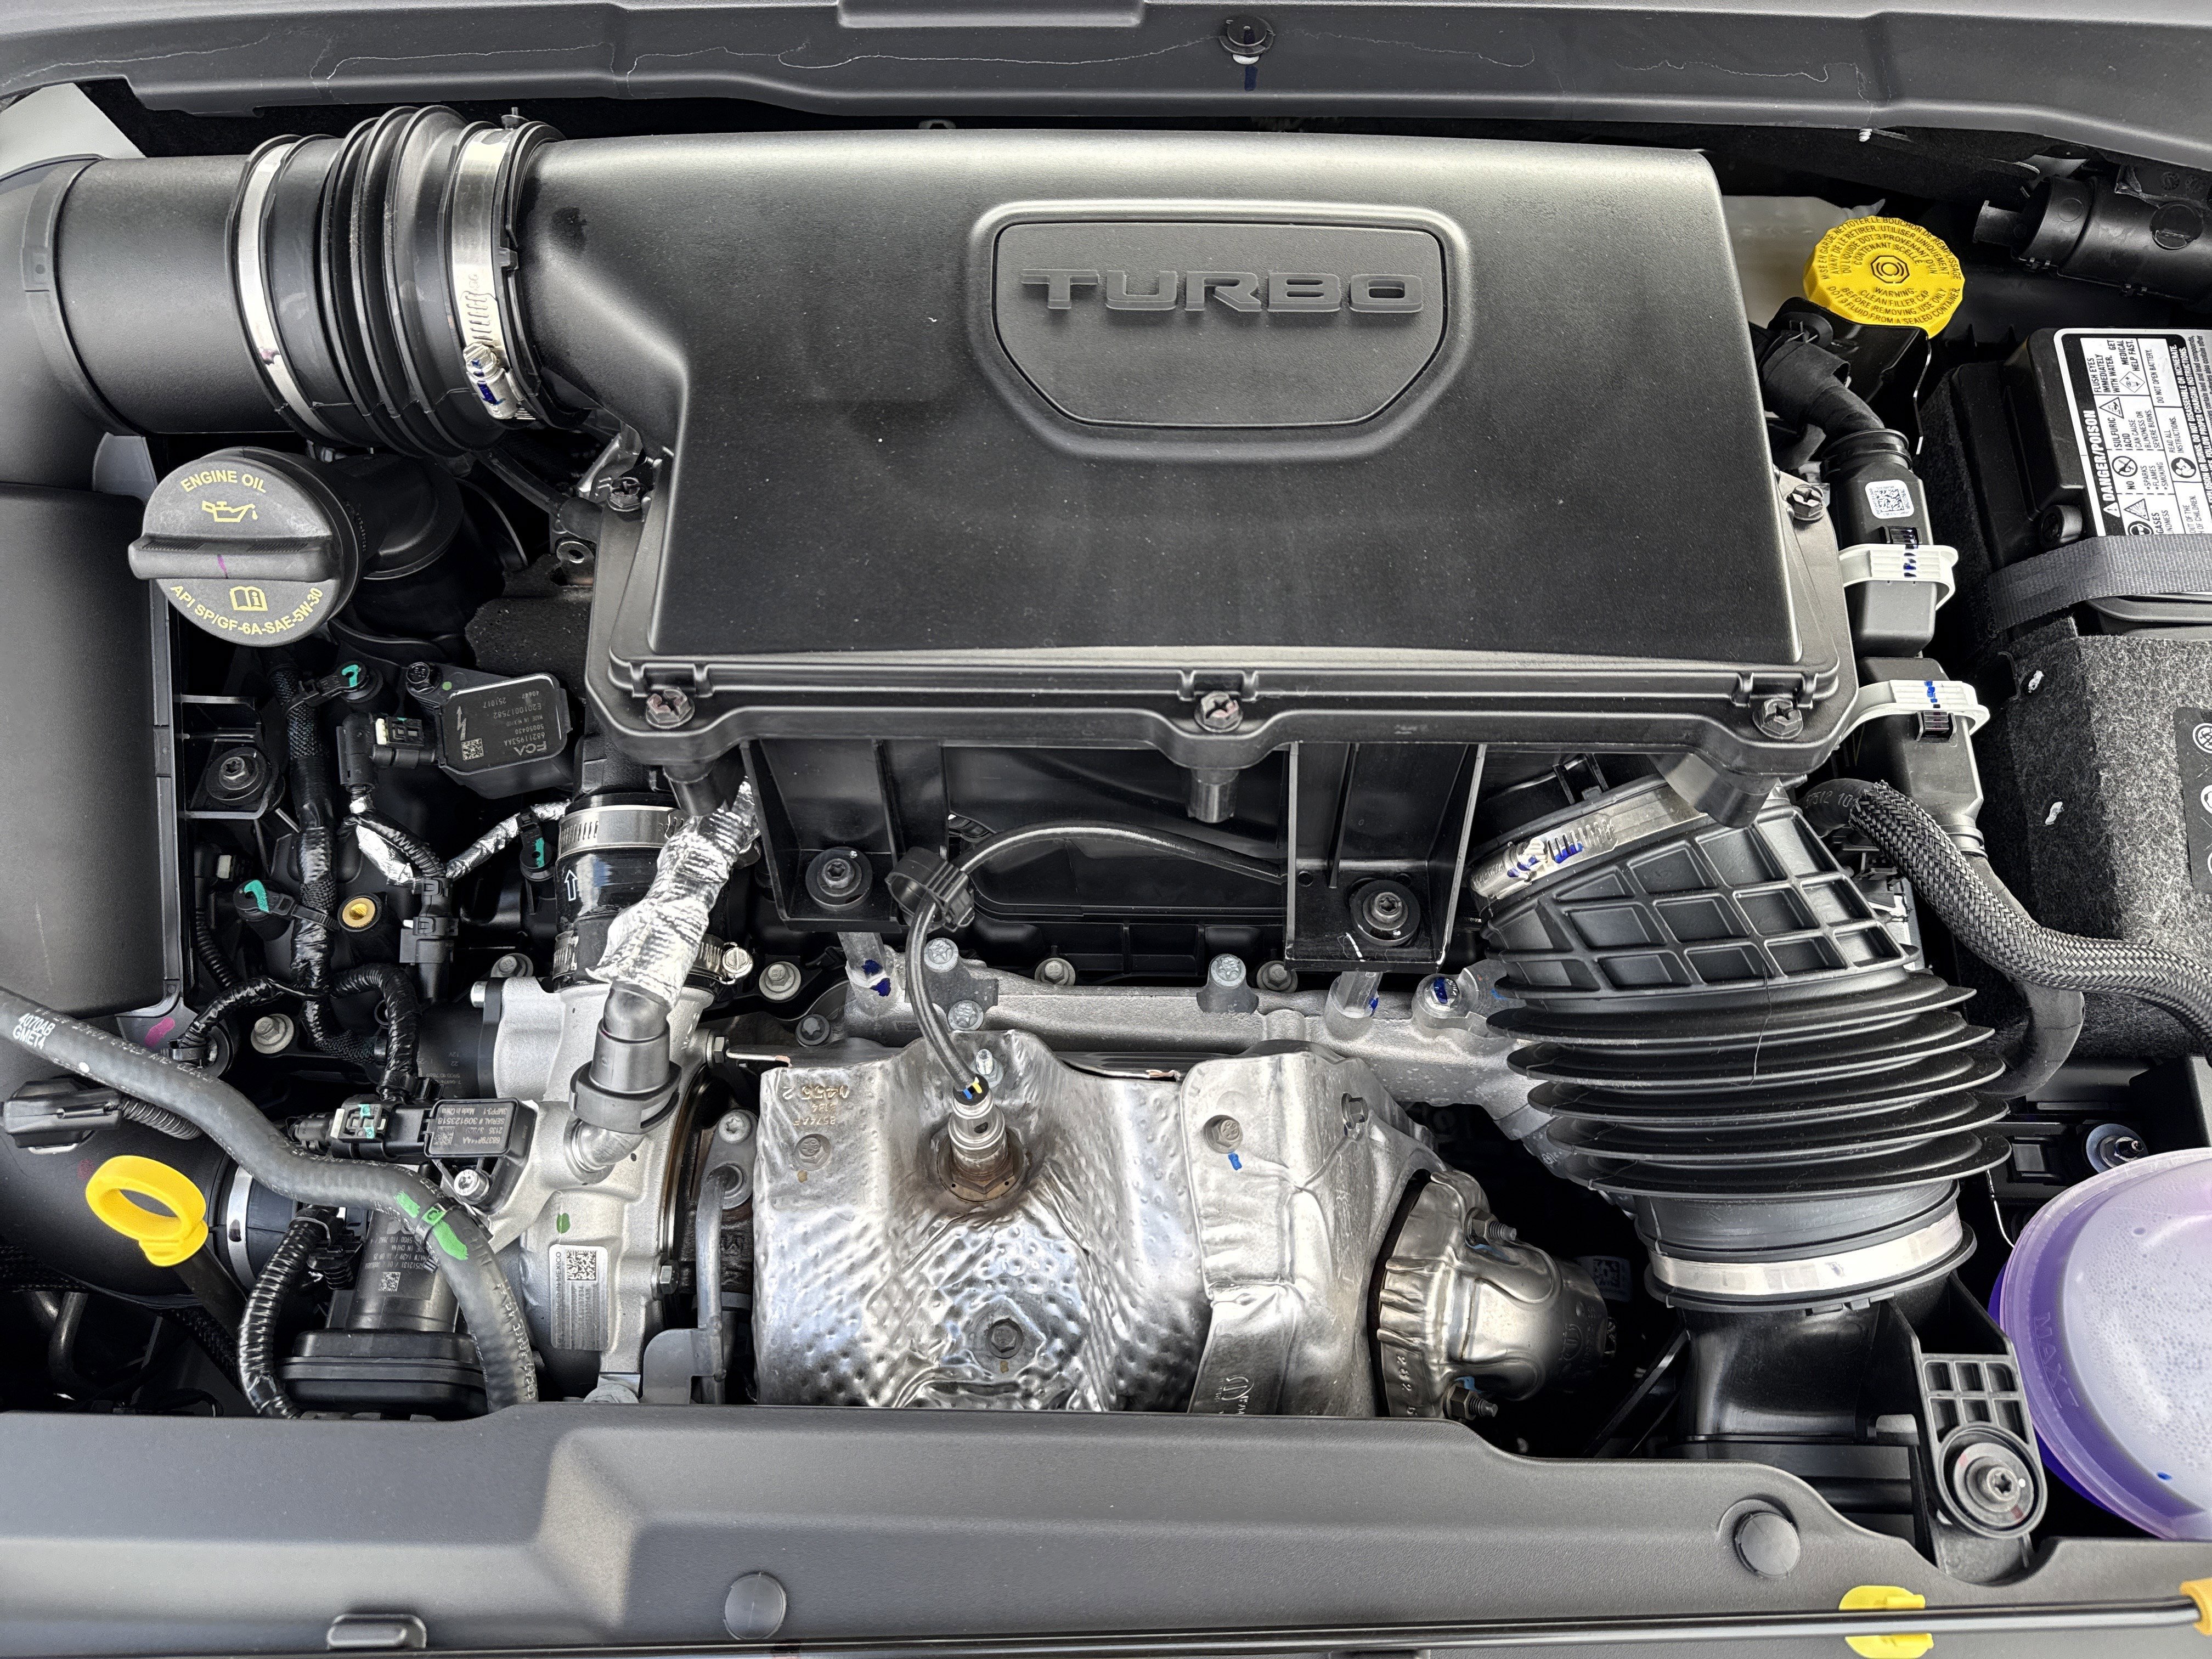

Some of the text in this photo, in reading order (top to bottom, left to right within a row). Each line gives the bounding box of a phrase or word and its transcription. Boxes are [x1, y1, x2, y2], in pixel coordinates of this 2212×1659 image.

[1833, 218, 1870, 235] NETTOYER
[1881, 225, 1916, 239] UTILISER
[1883, 217, 1922, 233] BOUCHON
[1922, 231, 1932, 239] DE
[1832, 245, 1841, 253] DE
[1837, 238, 1848, 247] LE
[1858, 235, 1874, 244] DOT
[1883, 234, 1930, 258] PROVENANT
[1818, 255, 1827, 263] EN
[1843, 241, 1860, 263] LIQUIDE
[1854, 242, 1891, 265] CONTENANT
[1916, 236, 1949, 275] UNIQUEMENT
[1933, 238, 1961, 280] REMPLISSAGE
[1819, 265, 1830, 280] MISE
[1831, 254, 1839, 274] AVANT
[1843, 265, 1852, 273] DU
[1022, 269, 1423, 313] TURBO
[1842, 287, 1871, 308] BEFORE
[1918, 302, 1935, 312] USE
[1932, 288, 1946, 303] ONLY
[1860, 290, 1929, 307] CLEAN FILLER CAP
[1828, 286, 1844, 299] DOT
[1845, 302, 1869, 317] FLUID
[1870, 313, 1893, 323] FROM
[1903, 314, 1932, 324] SEALED
[1932, 288, 1960, 317] CONTAINER
[2107, 340, 2116, 350] GET
[2117, 340, 2129, 365] MEDICAL
[2126, 340, 2140, 371] HELP FAST.
[2145, 349, 2156, 371] BATTERY.
[2169, 344, 2183, 376] INCINERATE.
[2179, 347, 2195, 385] INSTRUCTIONS.
[2087, 358, 2102, 393] FLUSH EYES
[2095, 354, 2111, 393] IMMEDIATELY
[2105, 356, 2120, 393] WITH WATER.
[2151, 372, 2159, 385] OPEN
[2154, 386, 2162, 395] NOT
[2188, 386, 2202, 413] CHARGING
[2179, 385, 2196, 421] DISASSEMBLE
[2107, 417, 2122, 448] SULFURIC
[2128, 419, 2142, 448] CAN CAUSE
[2137, 420, 2152, 448] BLINDNESS
[2169, 416, 2184, 453] INSTRUCTIONS.
[2188, 422, 2198, 433] NOT
[2196, 414, 2208, 435] PROPER
[2122, 433, 2133, 448] ACID
[2149, 429, 2161, 448] SEVERE
[2164, 430, 2176, 453] READ ALL
[2192, 434, 2200, 442] DO
[2201, 436, 2212, 458] FOLLOW
[2083, 410, 2115, 501] DANGER/POISON
[180, 470, 267, 493] ENGINE OIL
[2126, 481, 2136, 490] NO
[2140, 466, 2151, 487] SPARKS
[2149, 466, 2160, 487] FLAMES
[2156, 462, 2168, 487] SMOKING
[2182, 505, 2191, 514] THE
[2151, 512, 2164, 533] GASES
[2162, 510, 2173, 533] INDNESS
[2187, 523, 2196, 533] OUT
[170, 585, 324, 635] API SP/GF-6A-SAE-5W-30
[504, 732, 545, 747] 68211953AA
[514, 741, 547, 756] FCA
[19, 1013, 55, 1036] 4070AB
[438, 1117, 479, 1125] 309123518
